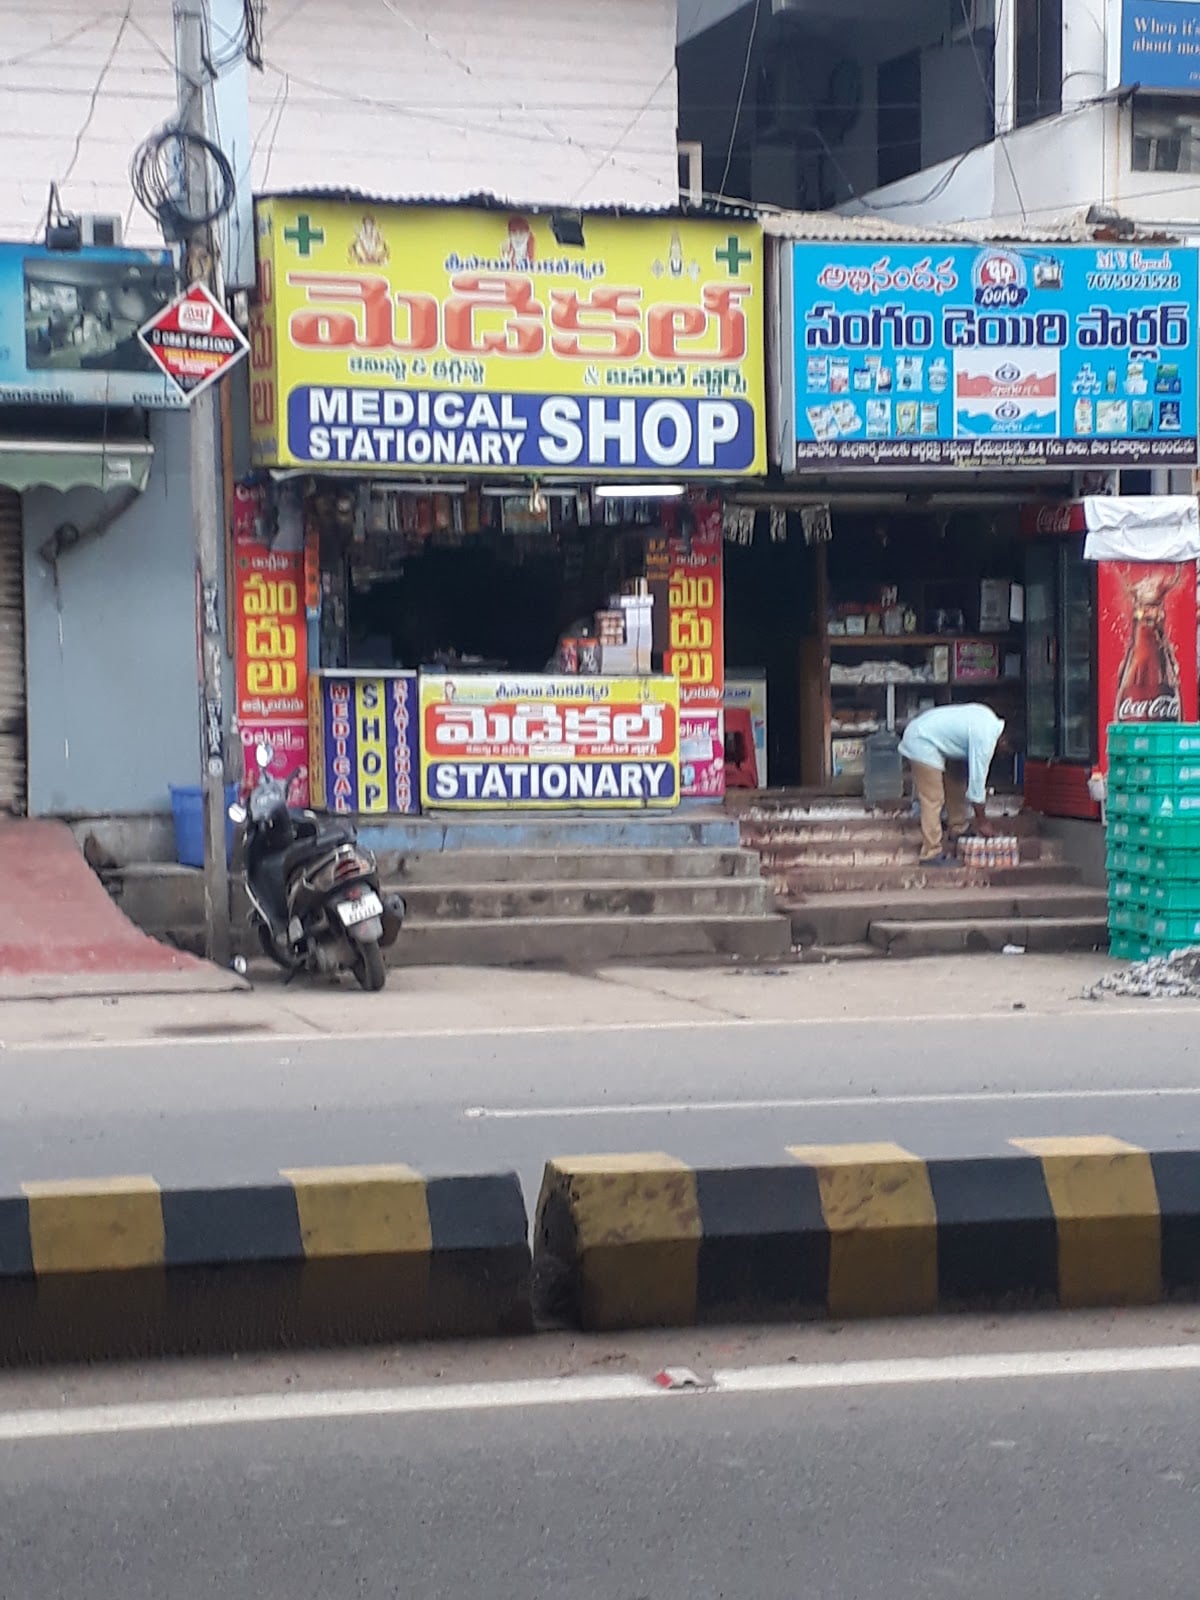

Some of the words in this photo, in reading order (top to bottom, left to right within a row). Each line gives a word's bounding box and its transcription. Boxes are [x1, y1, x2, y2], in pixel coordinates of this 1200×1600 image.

[1132, 37, 1172, 53] about
[1134, 17, 1177, 34] When
[819, 257, 957, 293] అభినందన
[287, 270, 752, 362] మెడికల్
[805, 304, 933, 349] సంగం
[942, 304, 1068, 350] డెయిరి
[1076, 303, 1190, 361] పార్లర్
[308, 388, 529, 428] MEDICAL
[308, 426, 525, 464] STATIONARY
[538, 398, 741, 466] SHOP
[434, 703, 667, 745] మెడికల్
[330, 683, 351, 813] MEDICAL
[361, 683, 384, 810] SHOP
[435, 763, 666, 798] STATIONARY
